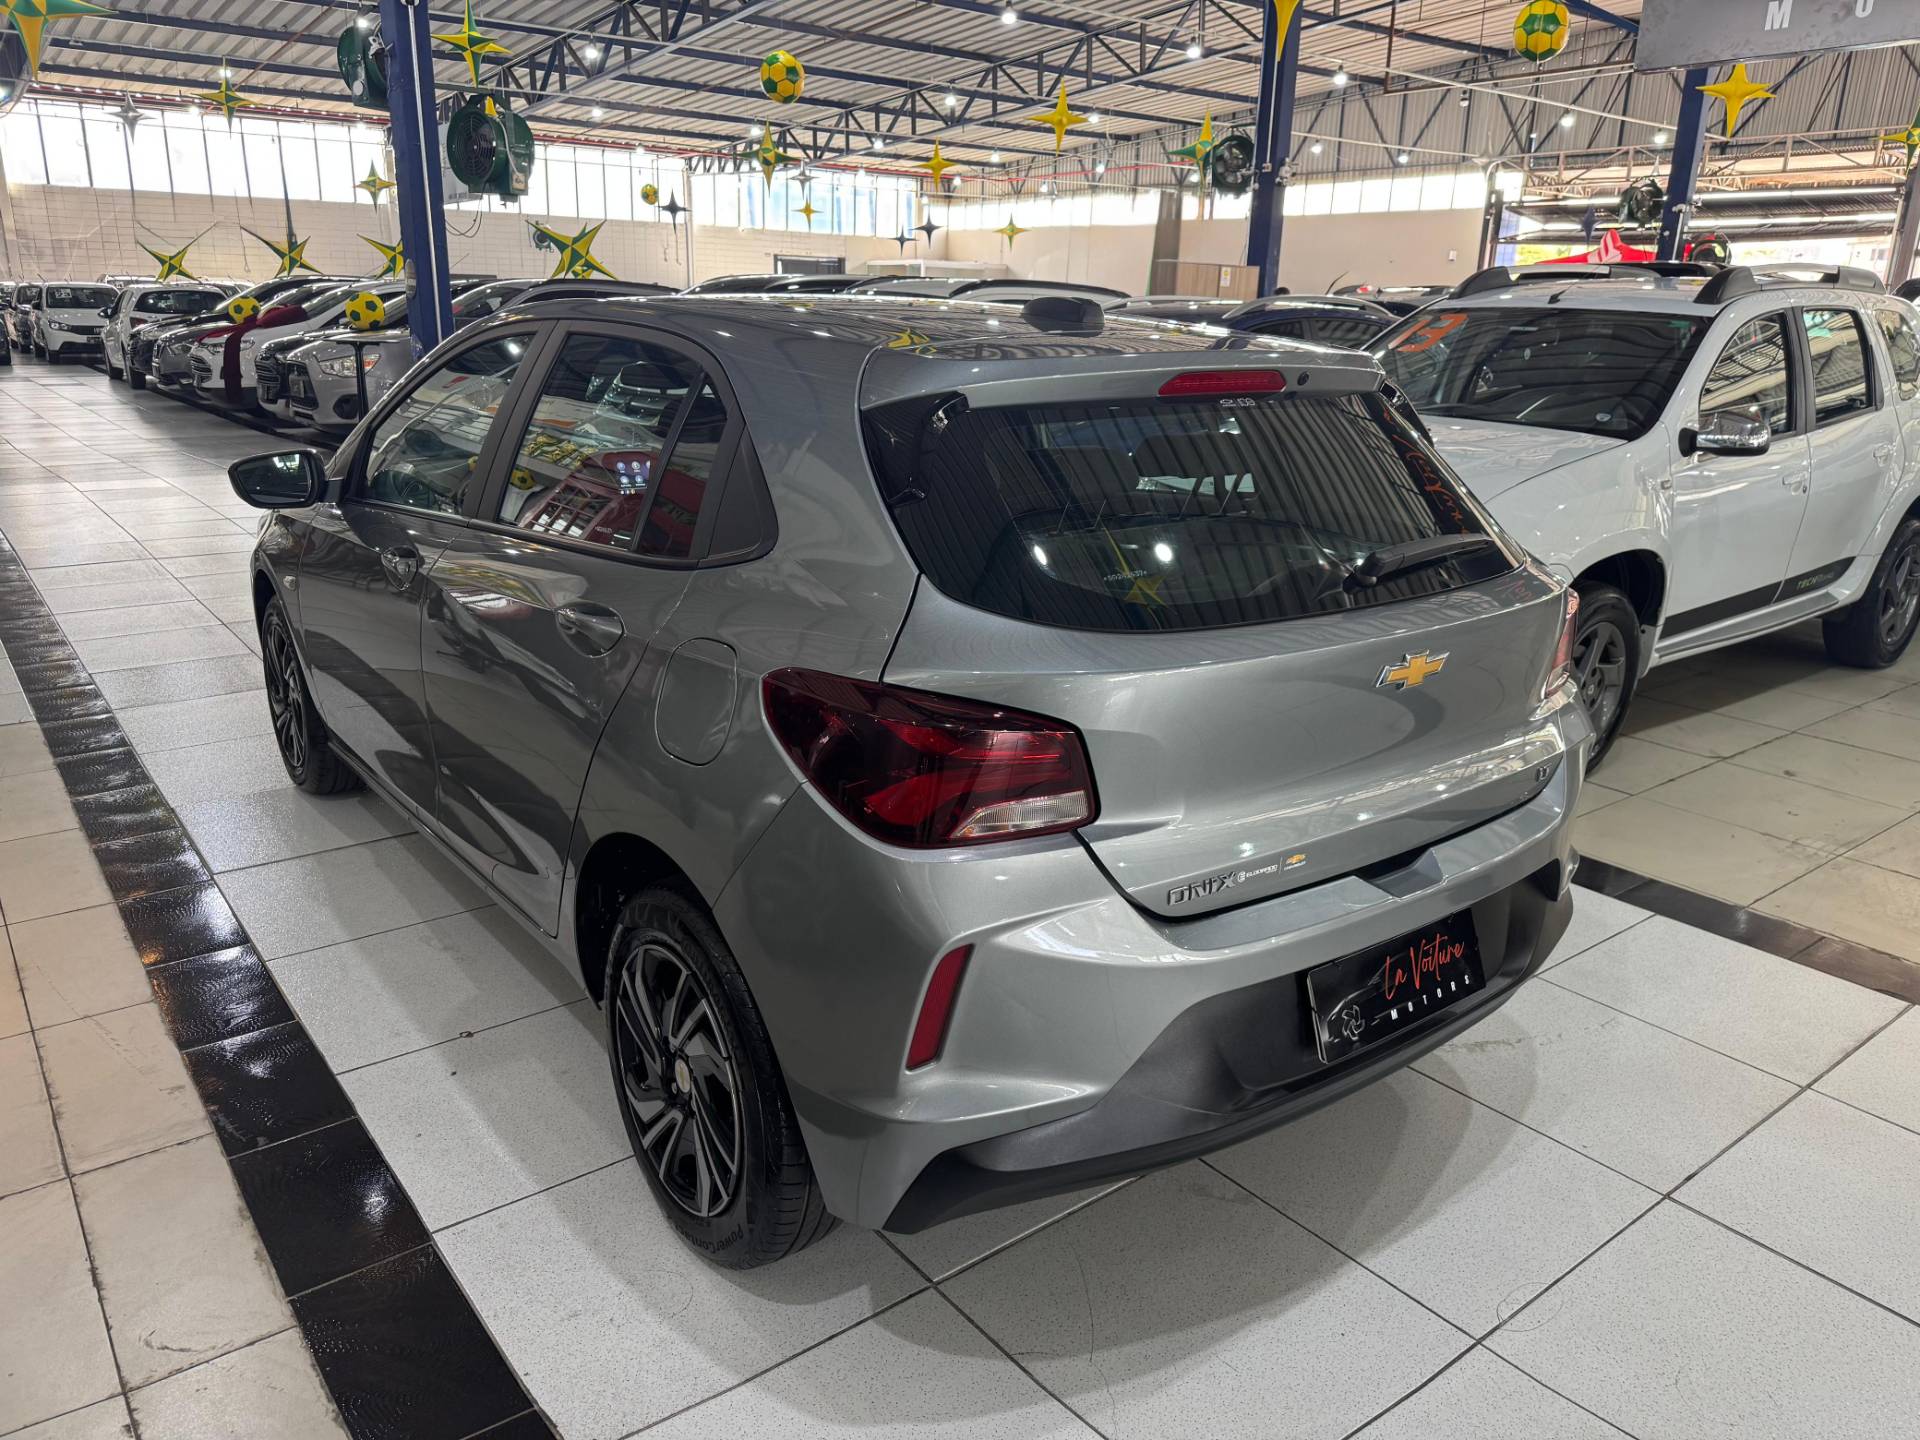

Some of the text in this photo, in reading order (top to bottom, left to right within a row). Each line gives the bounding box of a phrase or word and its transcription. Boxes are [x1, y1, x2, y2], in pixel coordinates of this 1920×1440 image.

[1167, 871, 1236, 906] ONIX
[1409, 933, 1465, 990] Voiture
[1391, 974, 1471, 1021] MOTORS
